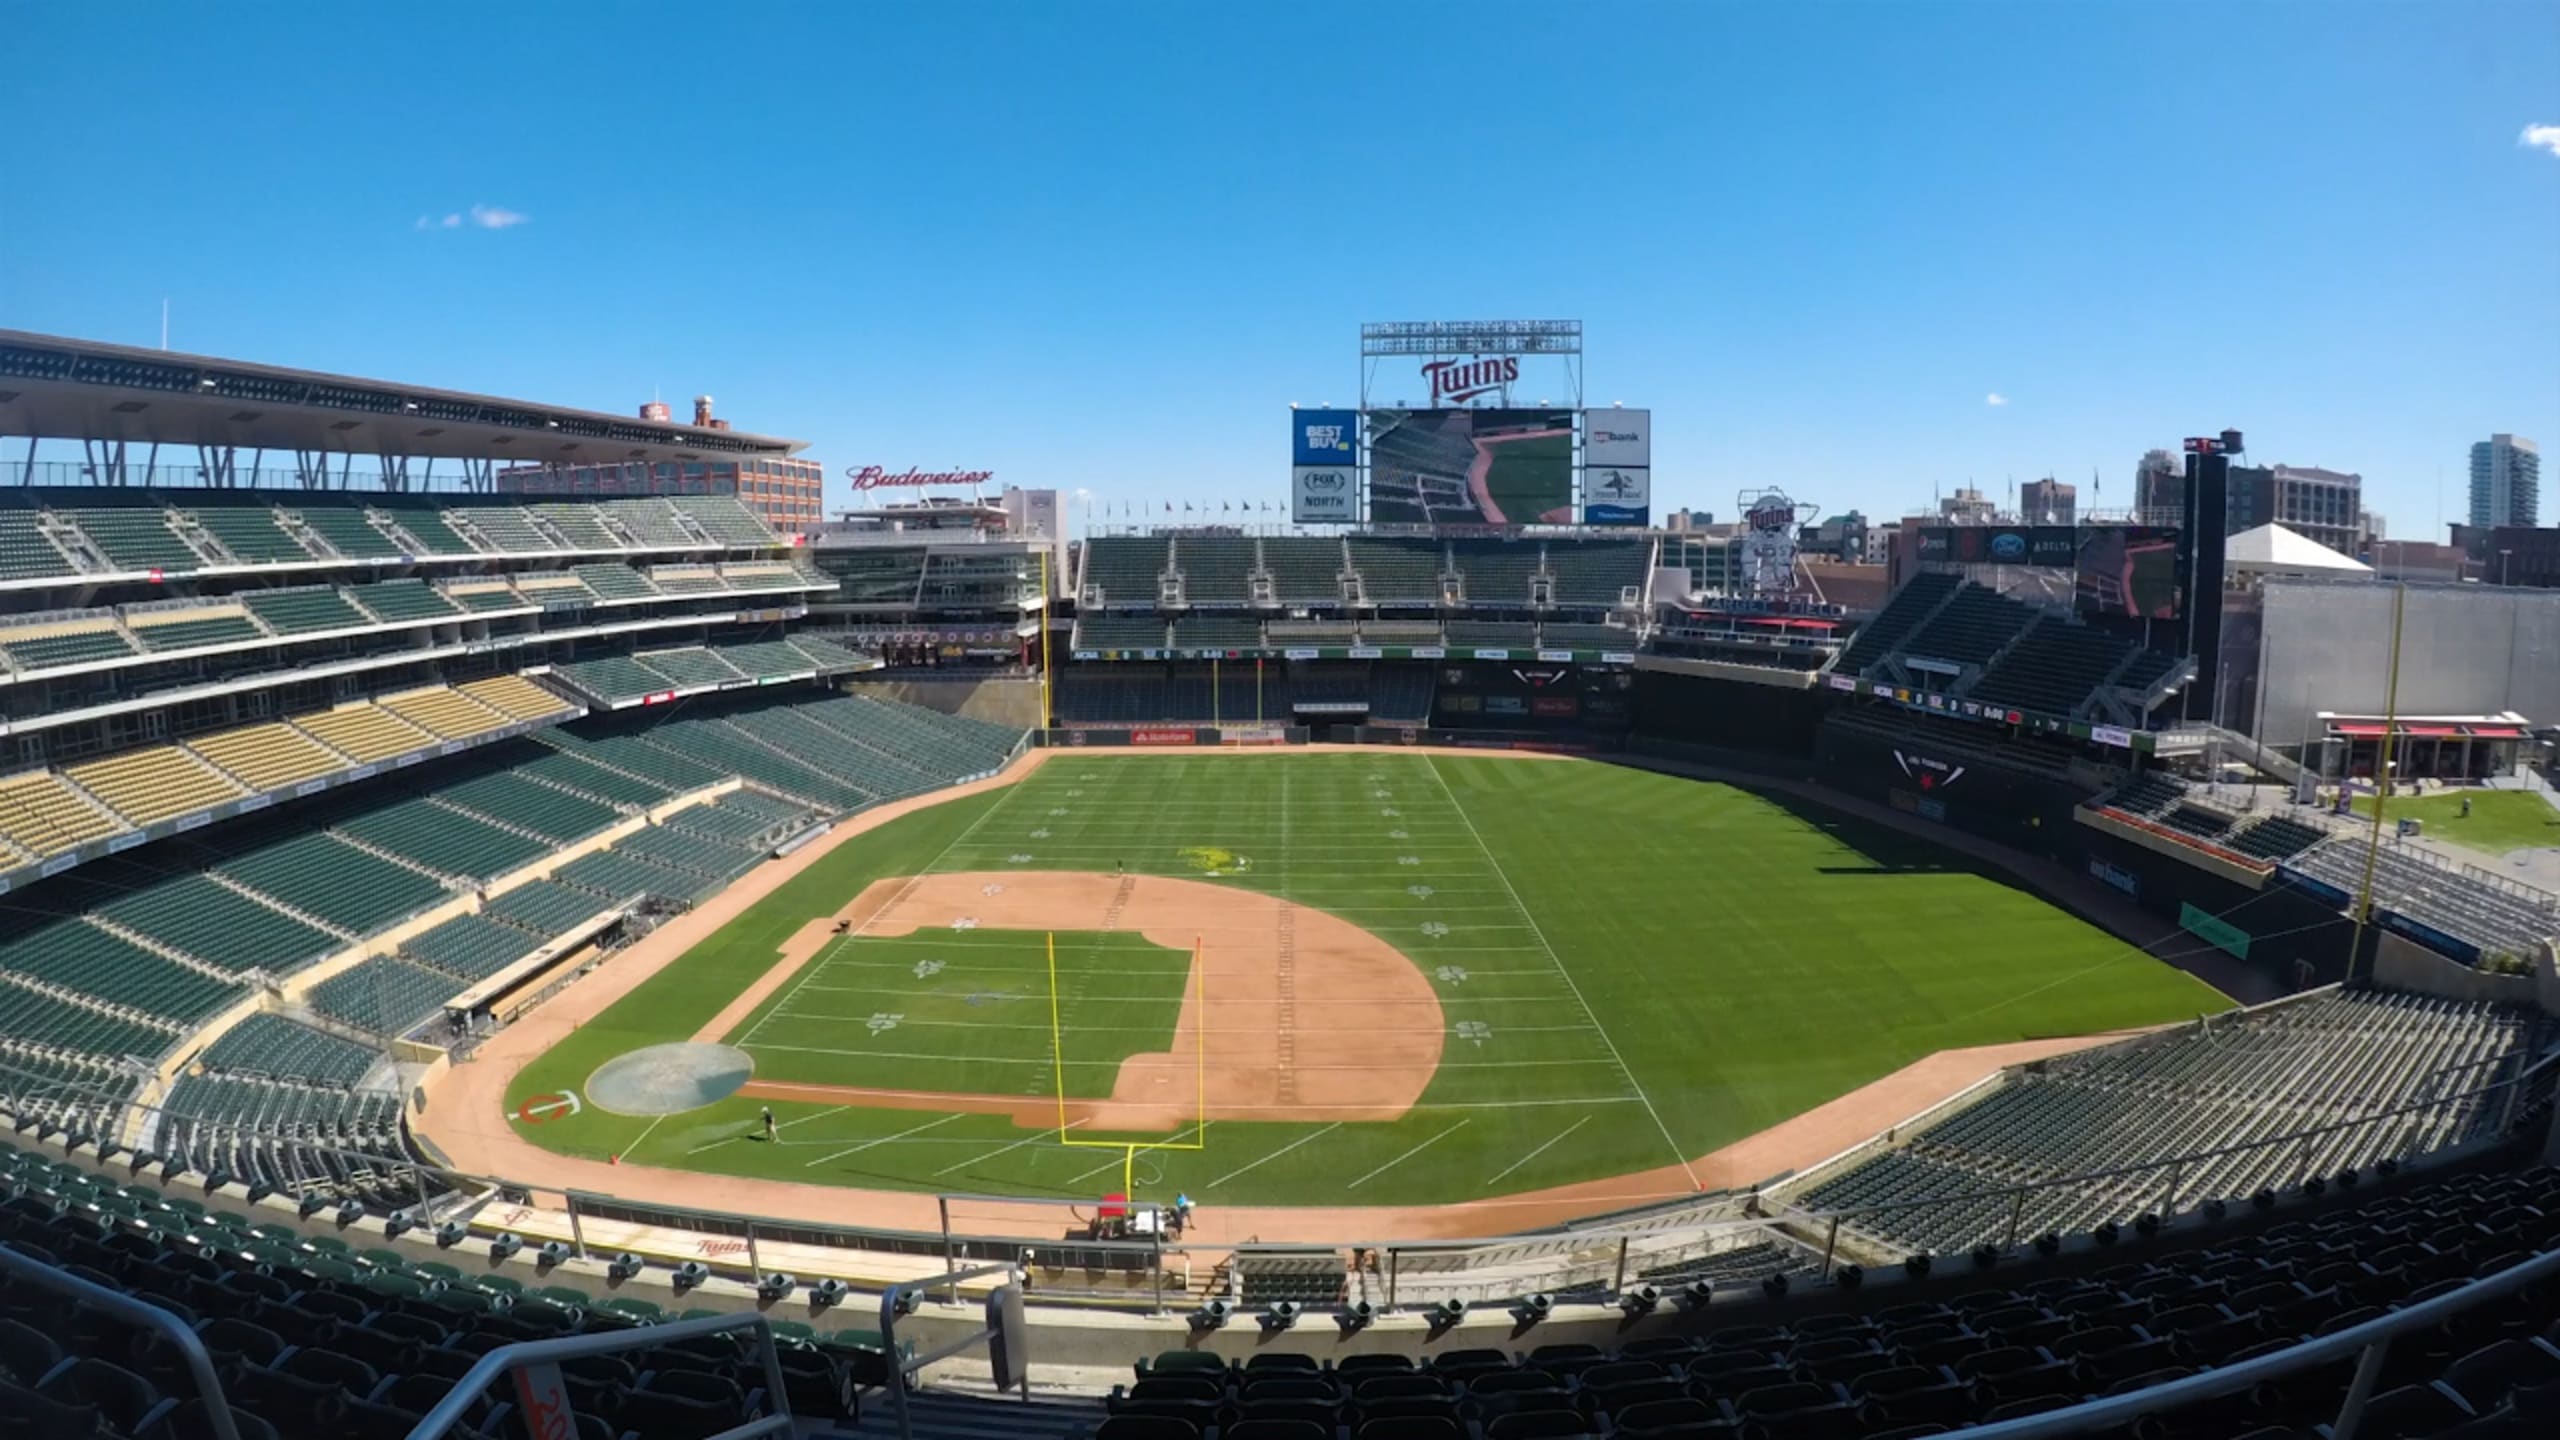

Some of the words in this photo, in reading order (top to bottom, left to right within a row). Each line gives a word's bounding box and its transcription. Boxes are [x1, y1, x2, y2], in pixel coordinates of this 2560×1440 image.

[1421, 357, 1518, 402] Twins
[1305, 425, 1343, 437] BEST
[1309, 437, 1340, 449] BUY
[846, 465, 993, 490] Budweiser
[1312, 473, 1336, 485] FOX
[1304, 496, 1345, 507] NORTH
[1744, 507, 1794, 531] Twins
[2043, 542, 2071, 552] DELTA
